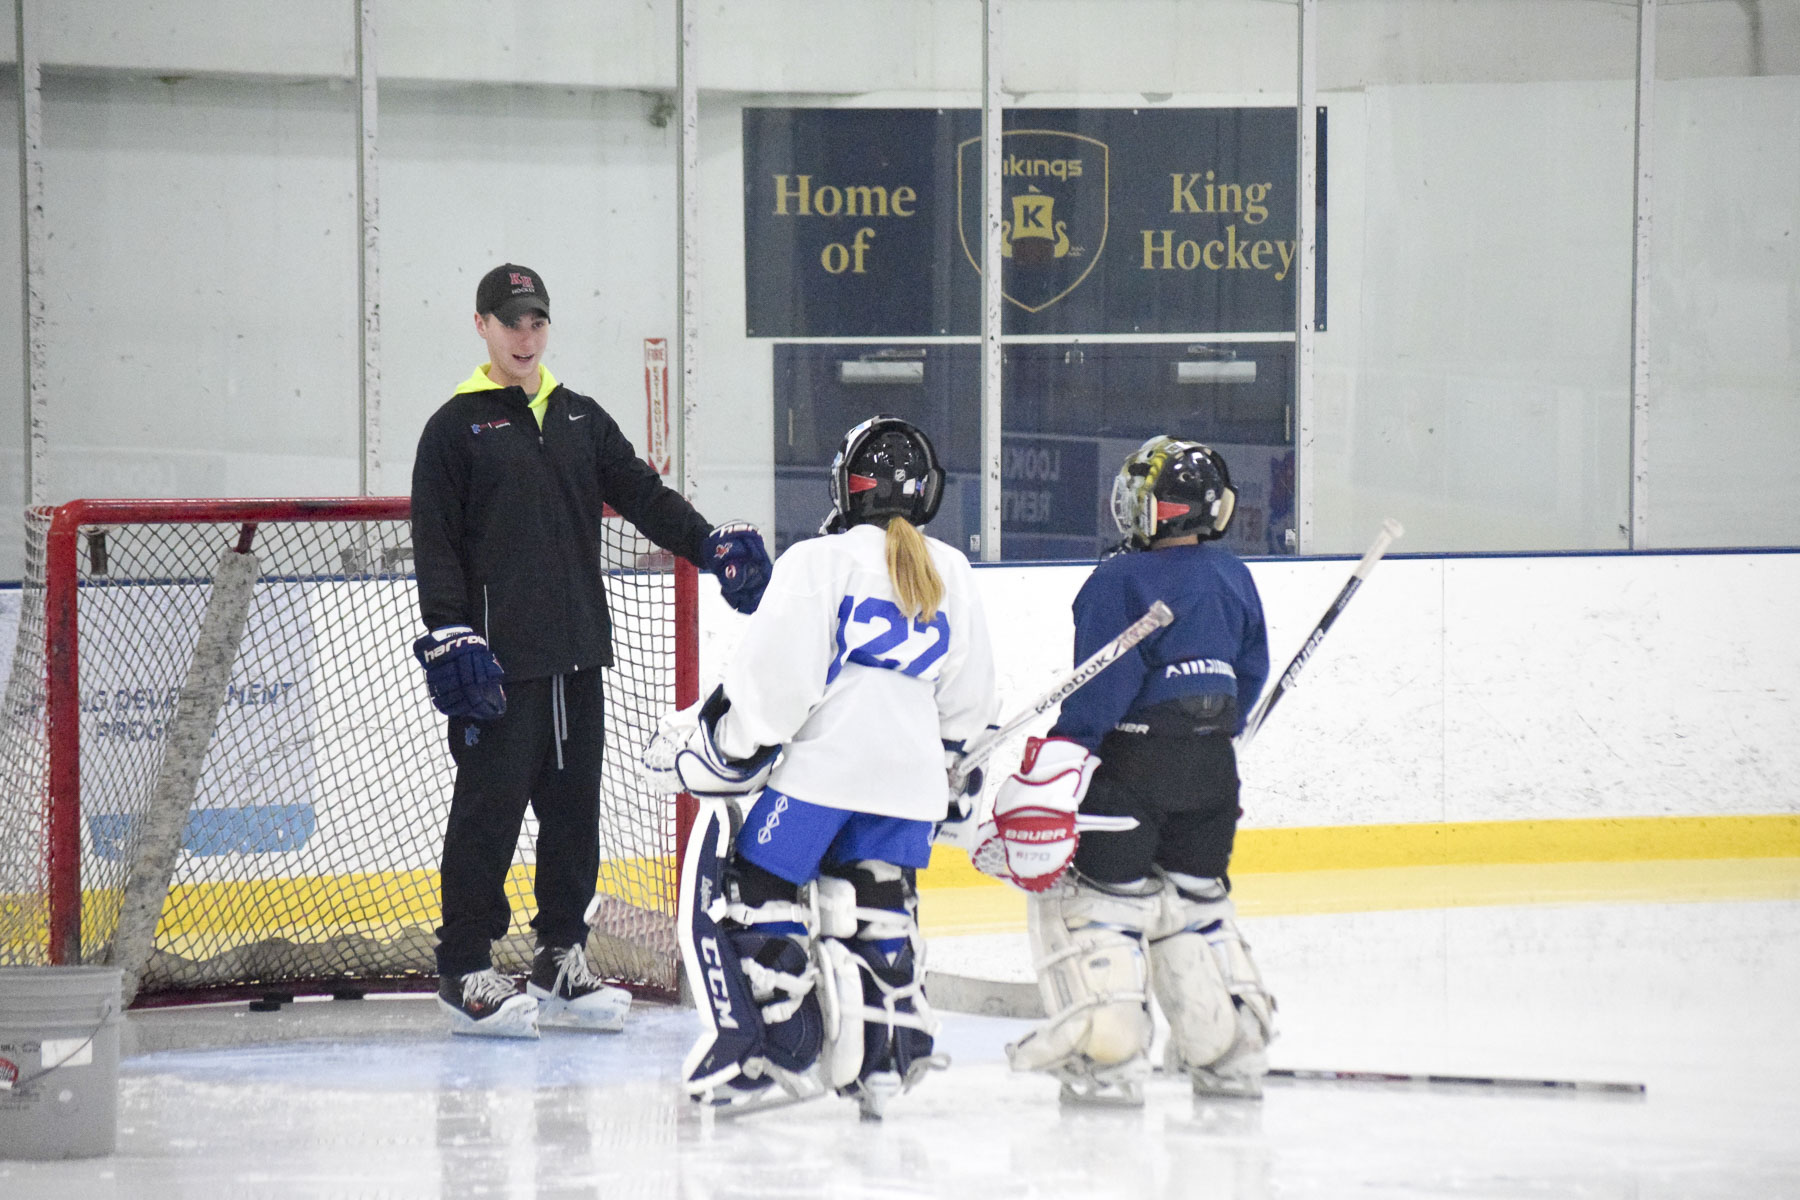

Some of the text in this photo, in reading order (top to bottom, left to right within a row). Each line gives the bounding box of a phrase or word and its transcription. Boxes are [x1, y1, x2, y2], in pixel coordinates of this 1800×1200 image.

[1003, 154, 1083, 182] ikings
[772, 174, 917, 217] Home
[1023, 205, 1044, 228] K
[1169, 170, 1272, 224] King
[821, 227, 875, 274] of
[1140, 224, 1297, 281] Hockey
[1114, 722, 1149, 734] UER
[1005, 828, 1067, 841] BAUER
[701, 936, 739, 1029] CCM
